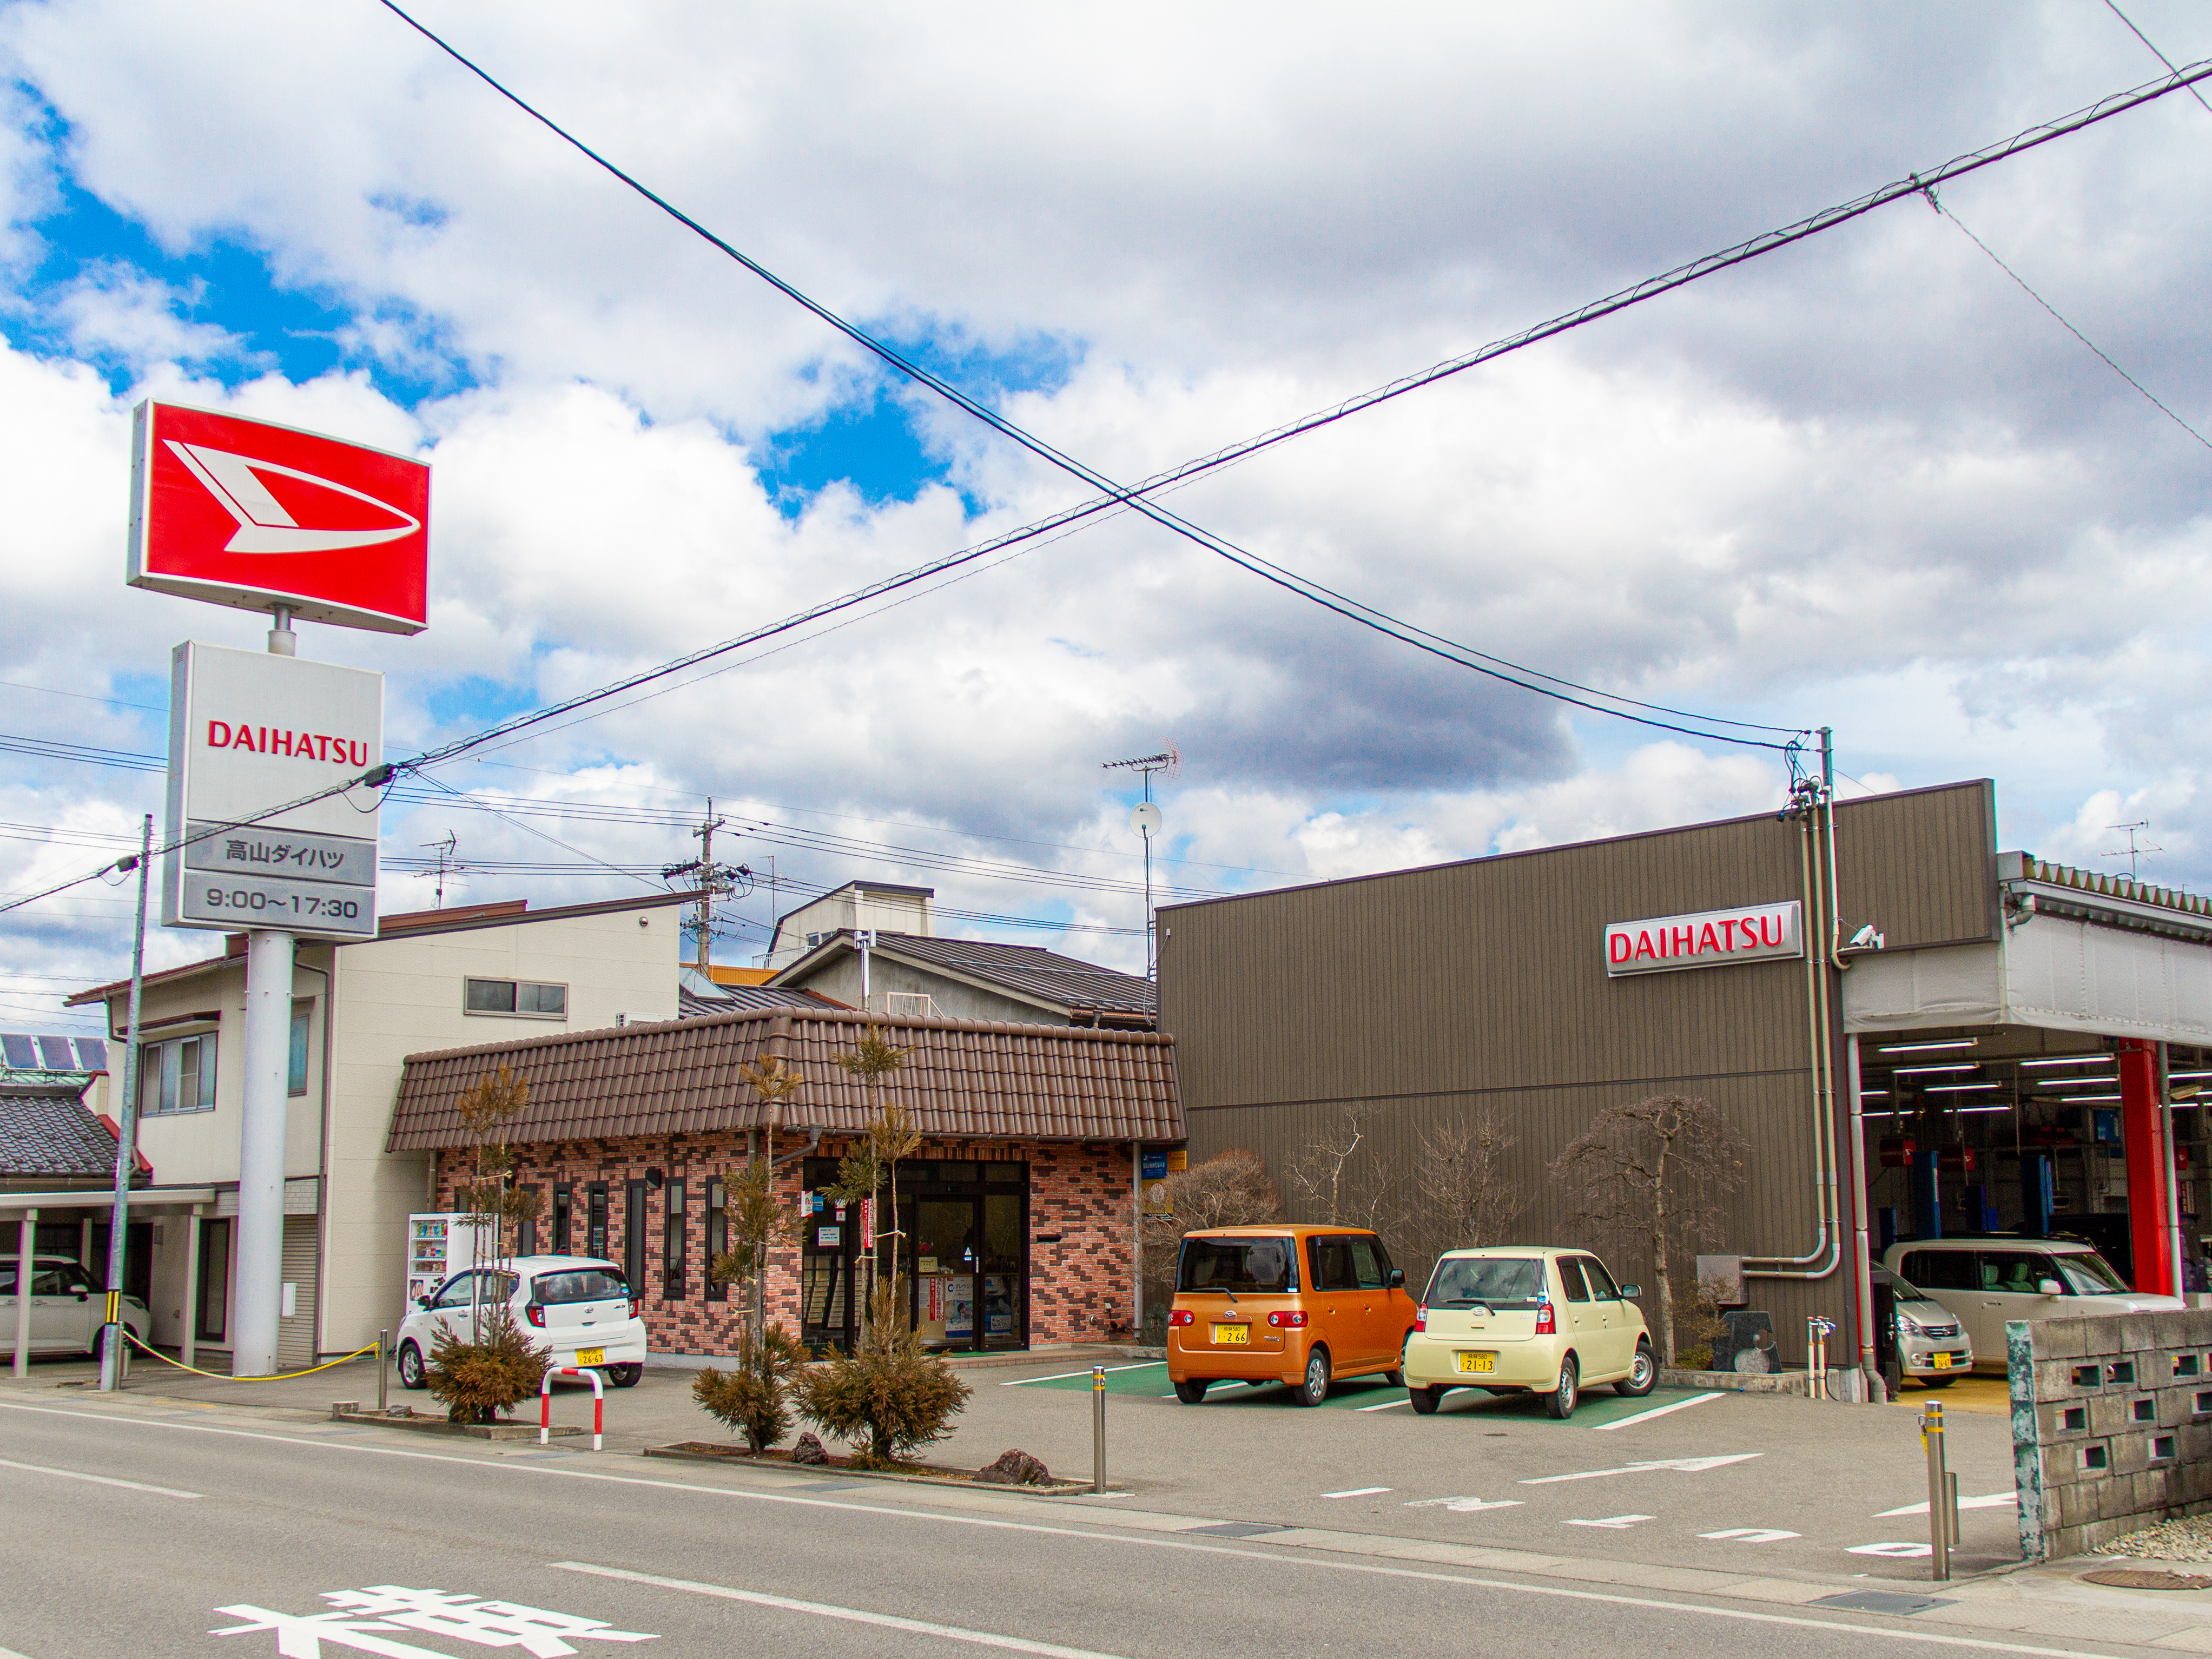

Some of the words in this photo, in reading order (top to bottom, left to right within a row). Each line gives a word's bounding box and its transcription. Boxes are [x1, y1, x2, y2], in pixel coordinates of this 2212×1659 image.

[208, 720, 368, 767] DAIHATSU
[226, 839, 345, 869] 高山ダイハツ
[1610, 914, 1782, 963] DAIHATSU
[1467, 1360, 1493, 1370] 21-13
